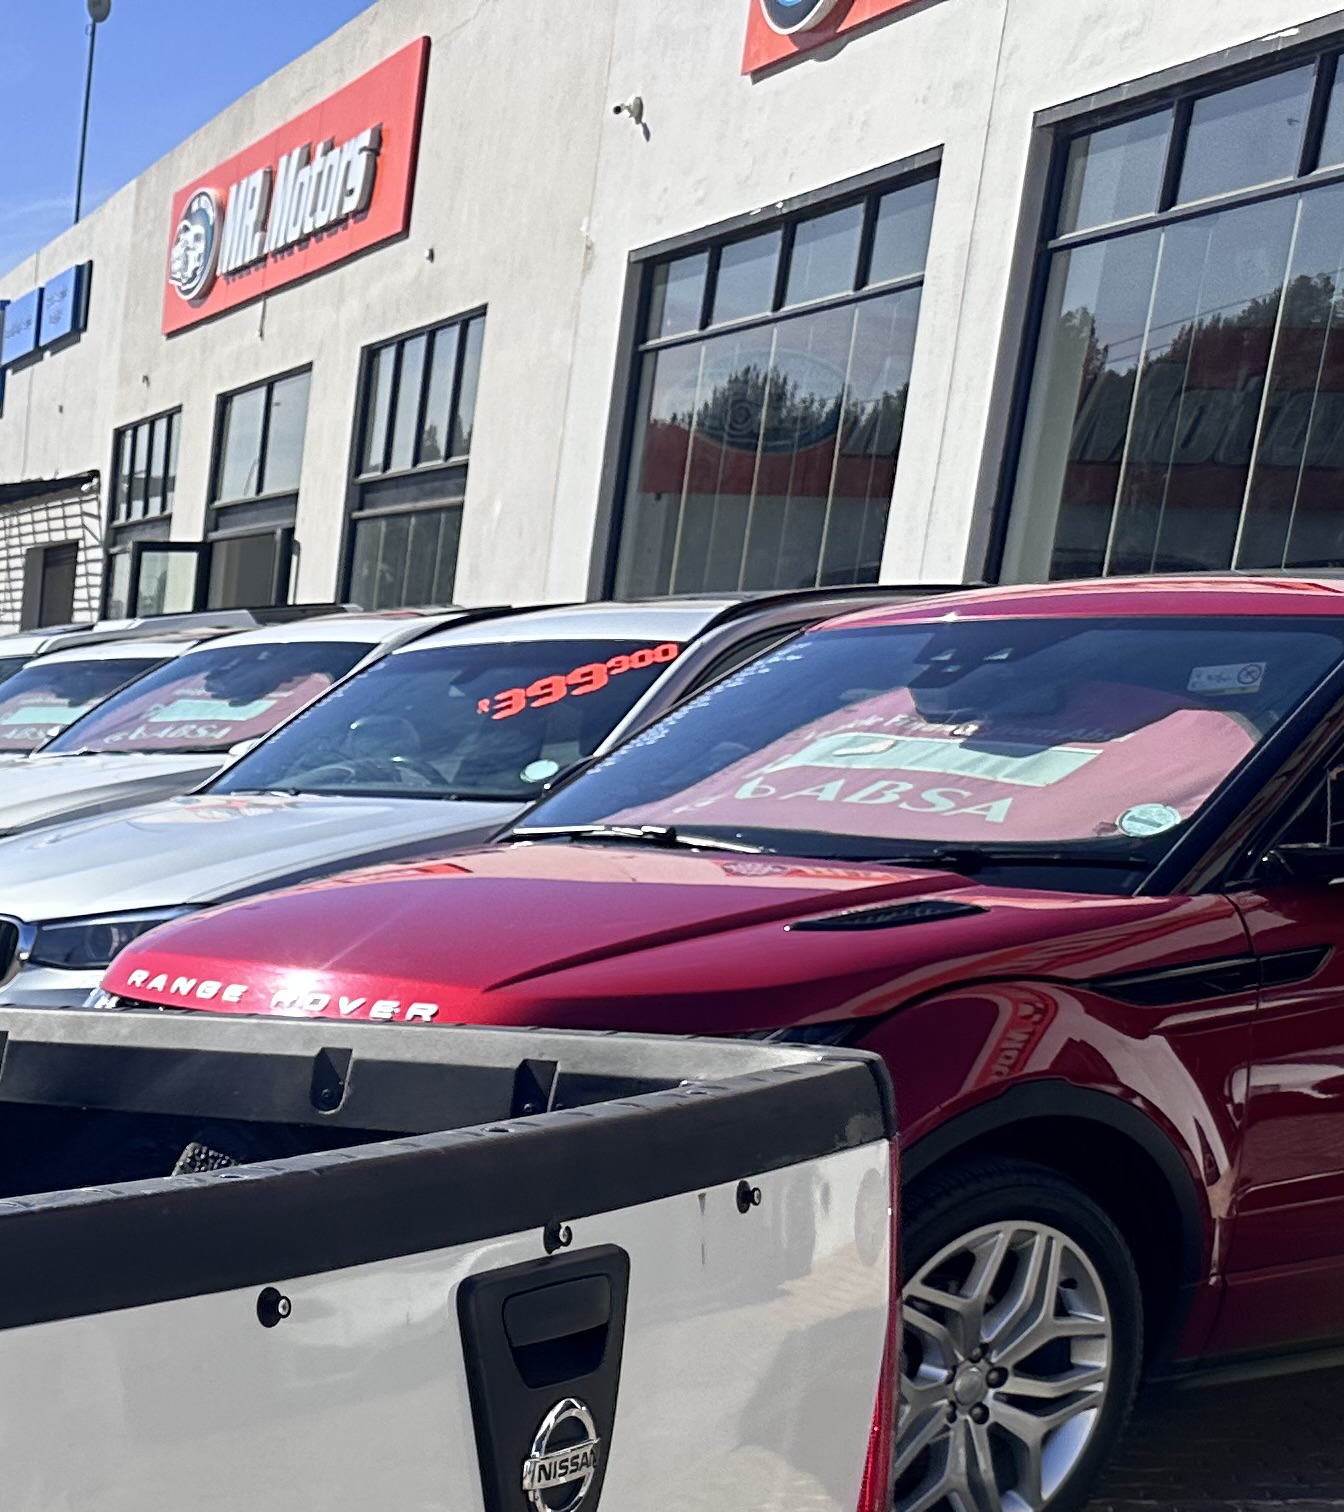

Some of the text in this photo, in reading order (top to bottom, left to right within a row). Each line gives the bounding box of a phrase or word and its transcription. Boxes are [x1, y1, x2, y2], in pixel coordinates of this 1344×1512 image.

[216, 124, 381, 277] MR. Motors
[779, 778, 1013, 824] ABSA
[127, 968, 440, 1023] RANGE ROVER
